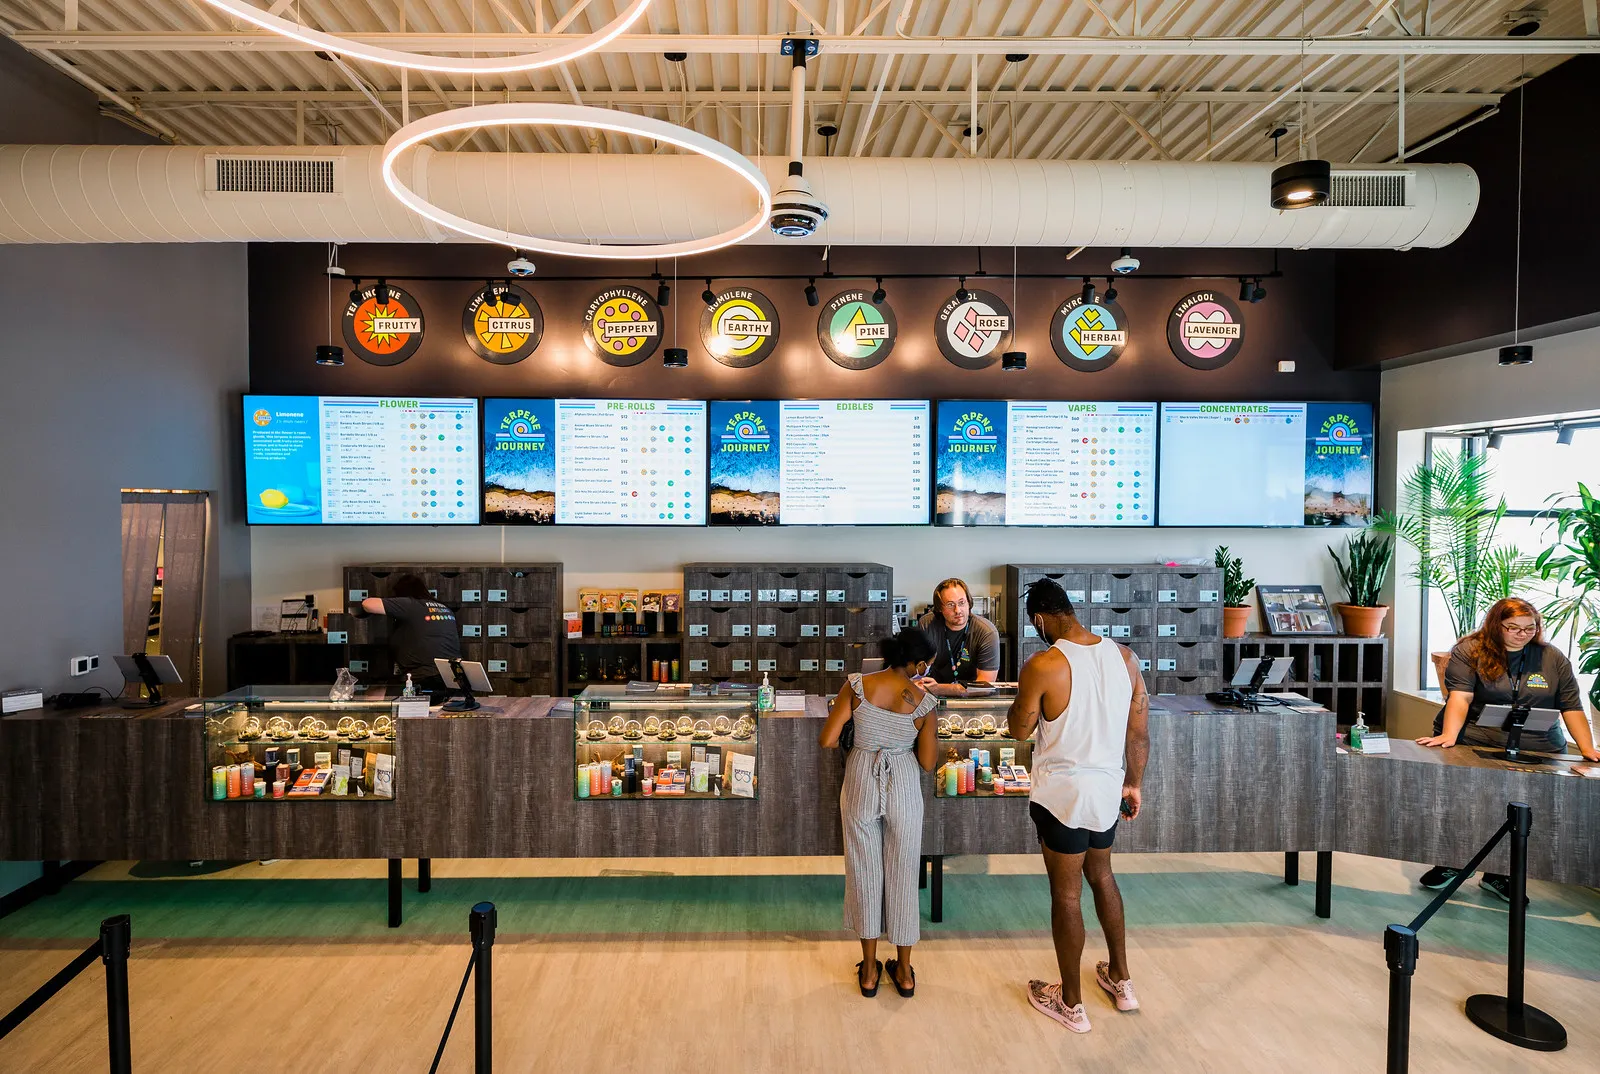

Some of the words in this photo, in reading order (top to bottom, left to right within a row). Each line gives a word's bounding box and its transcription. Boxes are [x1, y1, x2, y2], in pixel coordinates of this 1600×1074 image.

[585, 289, 648, 321] CARYOPHYLLENE
[708, 291, 753, 313] HUMULENE
[830, 293, 863, 310] PINENE
[1060, 296, 1100, 316] MYRCE
[1176, 294, 1214, 318] LINALOOL
[378, 322, 418, 330] FRUITY
[492, 321, 531, 330] CITRUS
[607, 325, 655, 333] PEPPERY
[728, 324, 769, 332] EARTHY
[860, 328, 885, 336] PINE
[1188, 326, 1237, 335] LAVENDER
[607, 402, 655, 410] PRE-ROLLS
[500, 409, 541, 430] TERPENE
[726, 411, 766, 432] TERPENE
[953, 412, 993, 432] TERPENE
[1320, 414, 1359, 434] TERPENE
[495, 442, 545, 451] JOURNEY
[721, 444, 770, 452] JOURNEY
[948, 444, 997, 453] JOURNEY
[1315, 446, 1362, 454] JOURNEY
